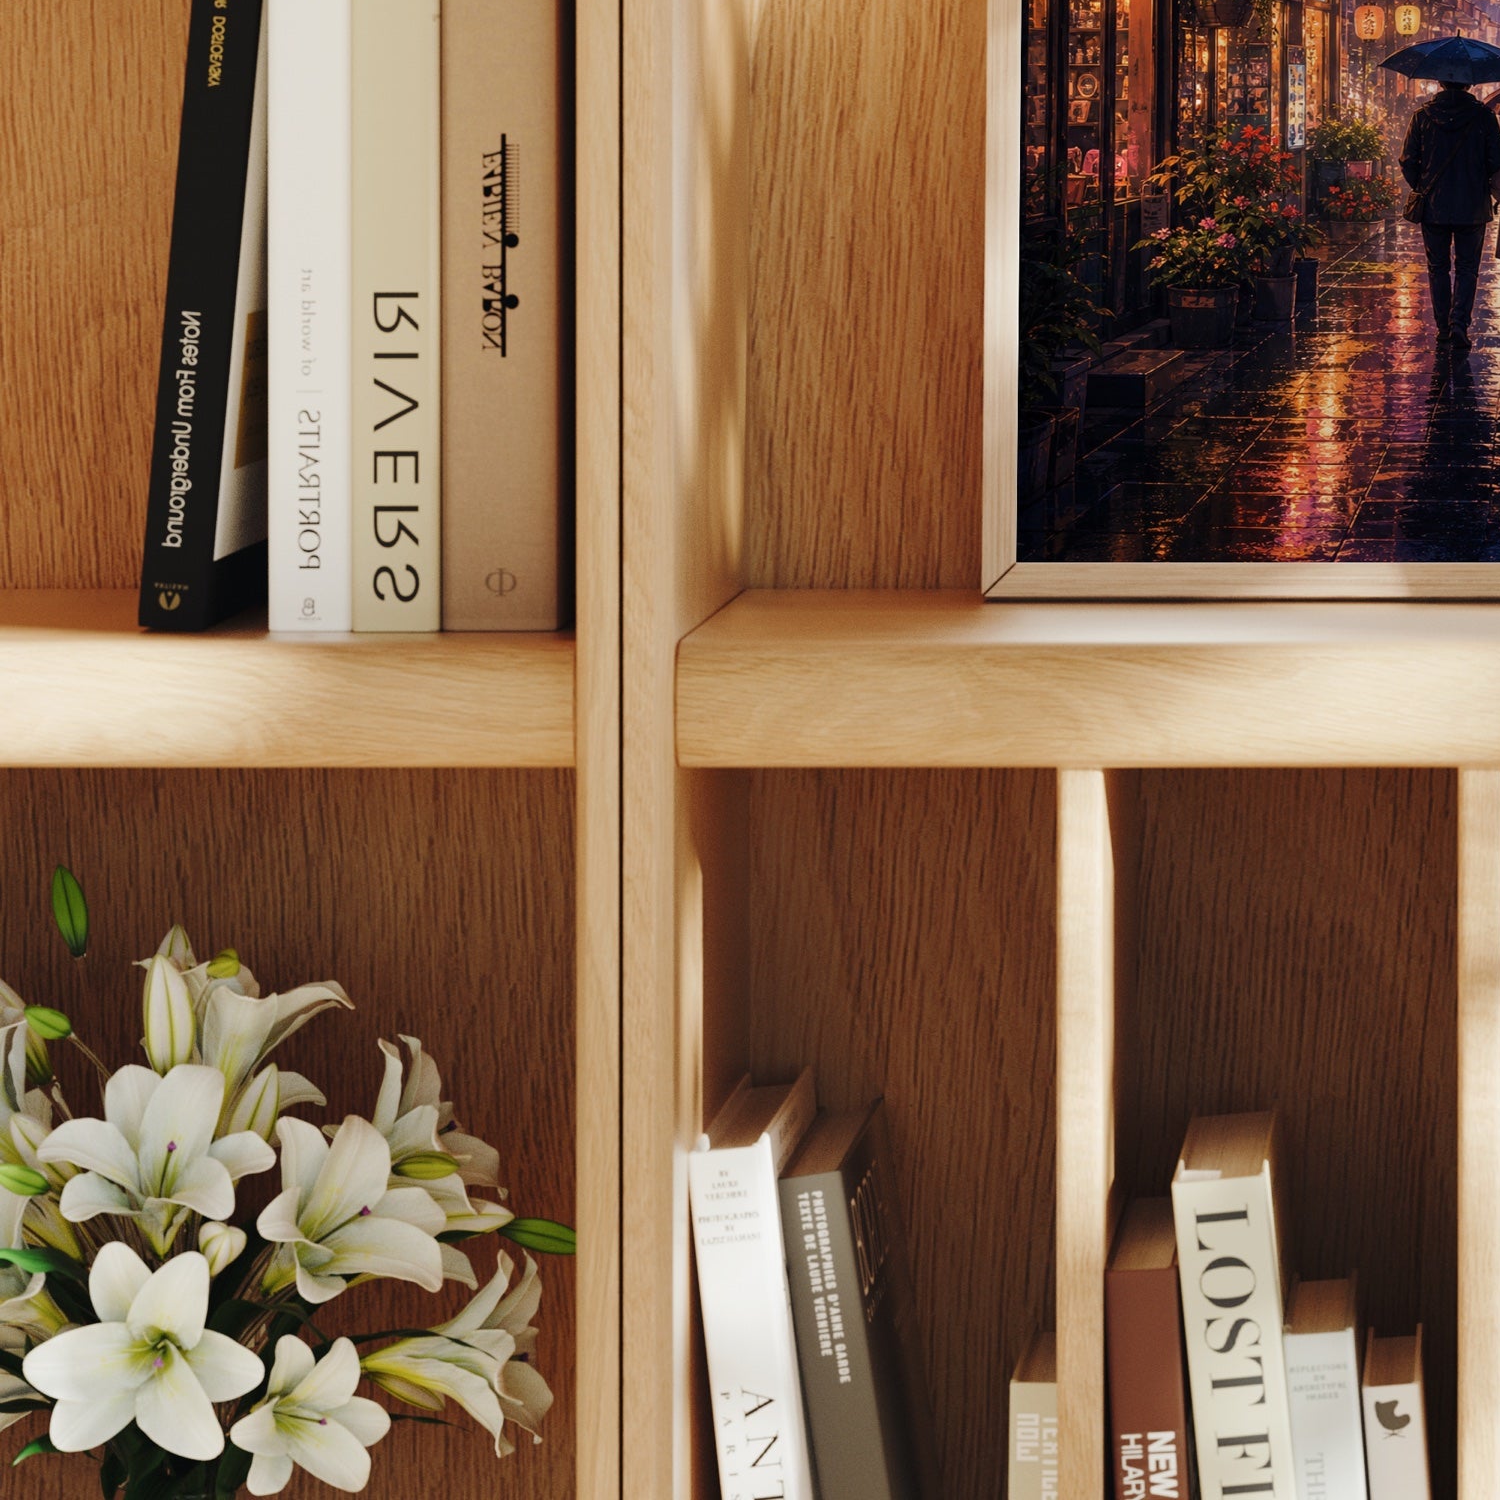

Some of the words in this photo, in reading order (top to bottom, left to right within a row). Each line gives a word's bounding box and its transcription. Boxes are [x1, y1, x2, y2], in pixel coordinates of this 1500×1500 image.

[797, 1191, 812, 1231] TEXTE
[804, 1233, 815, 1252] DE
[810, 1190, 837, 1290] PHOTOGRAPHIES
[806, 1254, 823, 1294] LAURE
[826, 1294, 845, 1340] D'ANNE
[1194, 1203, 1267, 1407] LOST
[833, 1343, 852, 1384] GARDE
[1146, 1430, 1179, 1499] NEW
